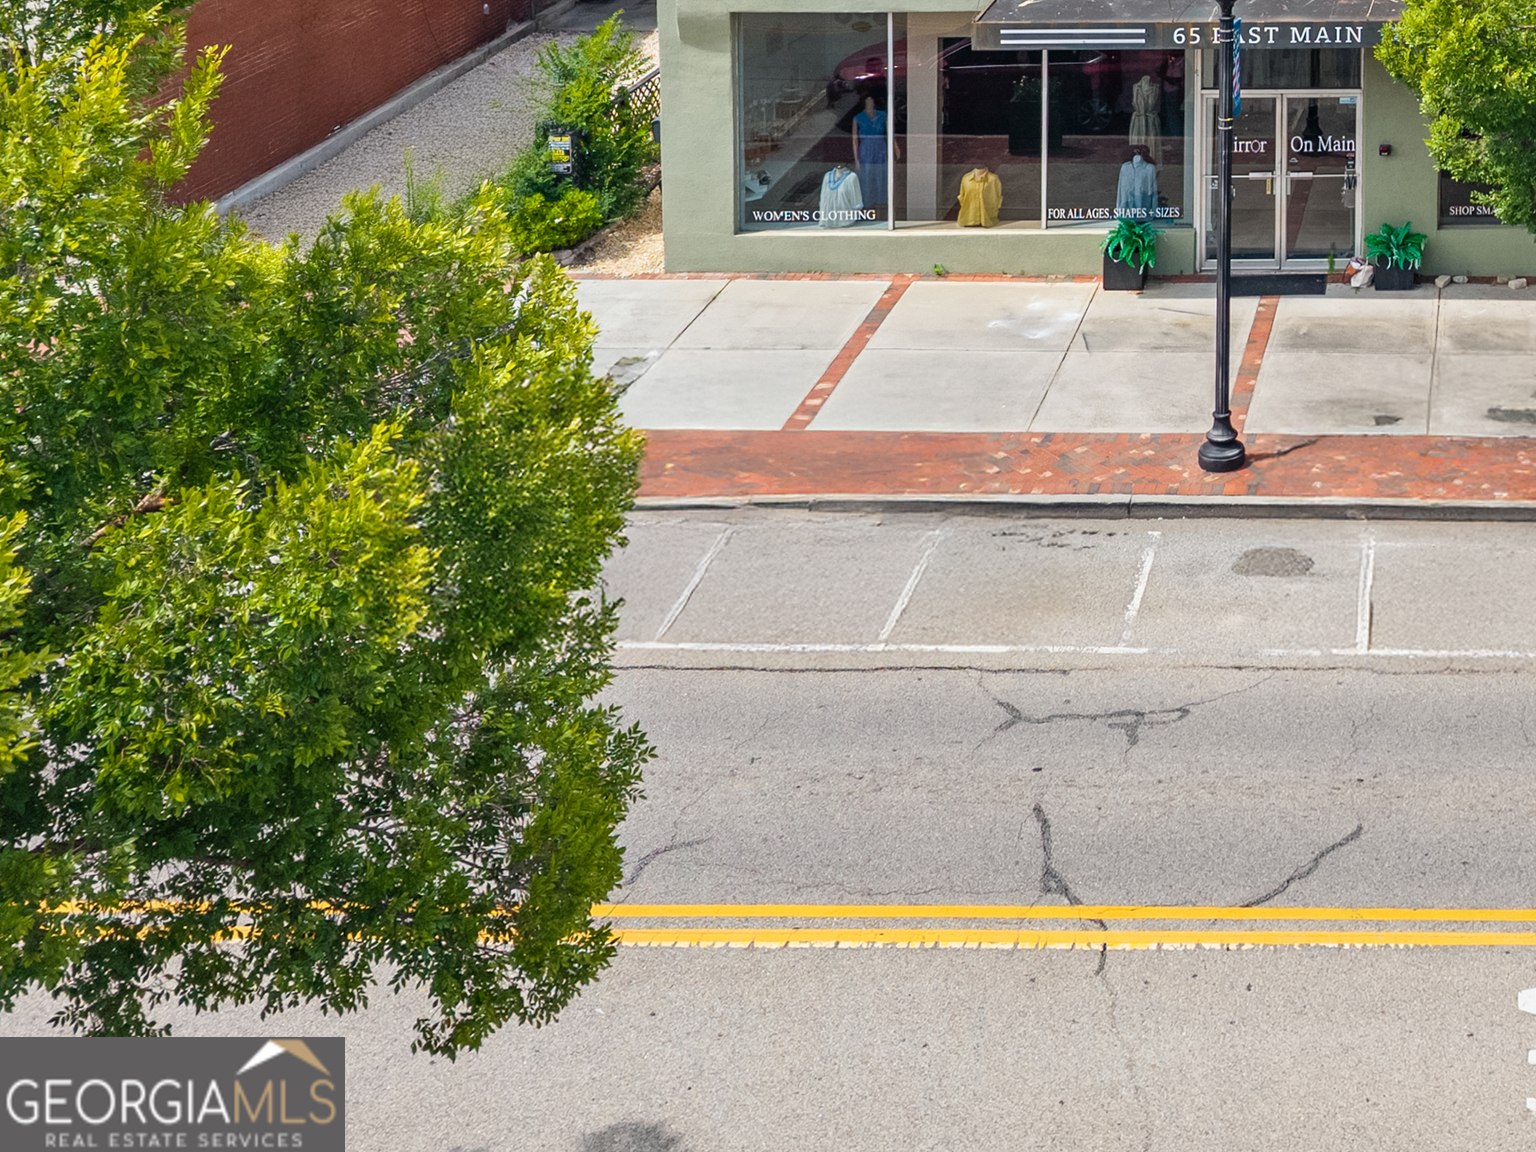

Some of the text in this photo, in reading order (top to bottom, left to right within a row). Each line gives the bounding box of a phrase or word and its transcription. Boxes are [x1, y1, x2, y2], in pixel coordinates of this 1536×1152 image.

[1173, 26, 1201, 44] 65
[1290, 26, 1364, 44] MAIN
[1233, 135, 1356, 153] irror On Main
[752, 209, 876, 221] WOMEN'S CLOTHING
[1048, 208, 1066, 219] FOR
[1067, 208, 1085, 219] ALL
[1086, 208, 1112, 220] AGES,
[1113, 207, 1147, 218] SHAPES
[1155, 207, 1180, 218] SIZES
[1449, 206, 1475, 216] SHOP
